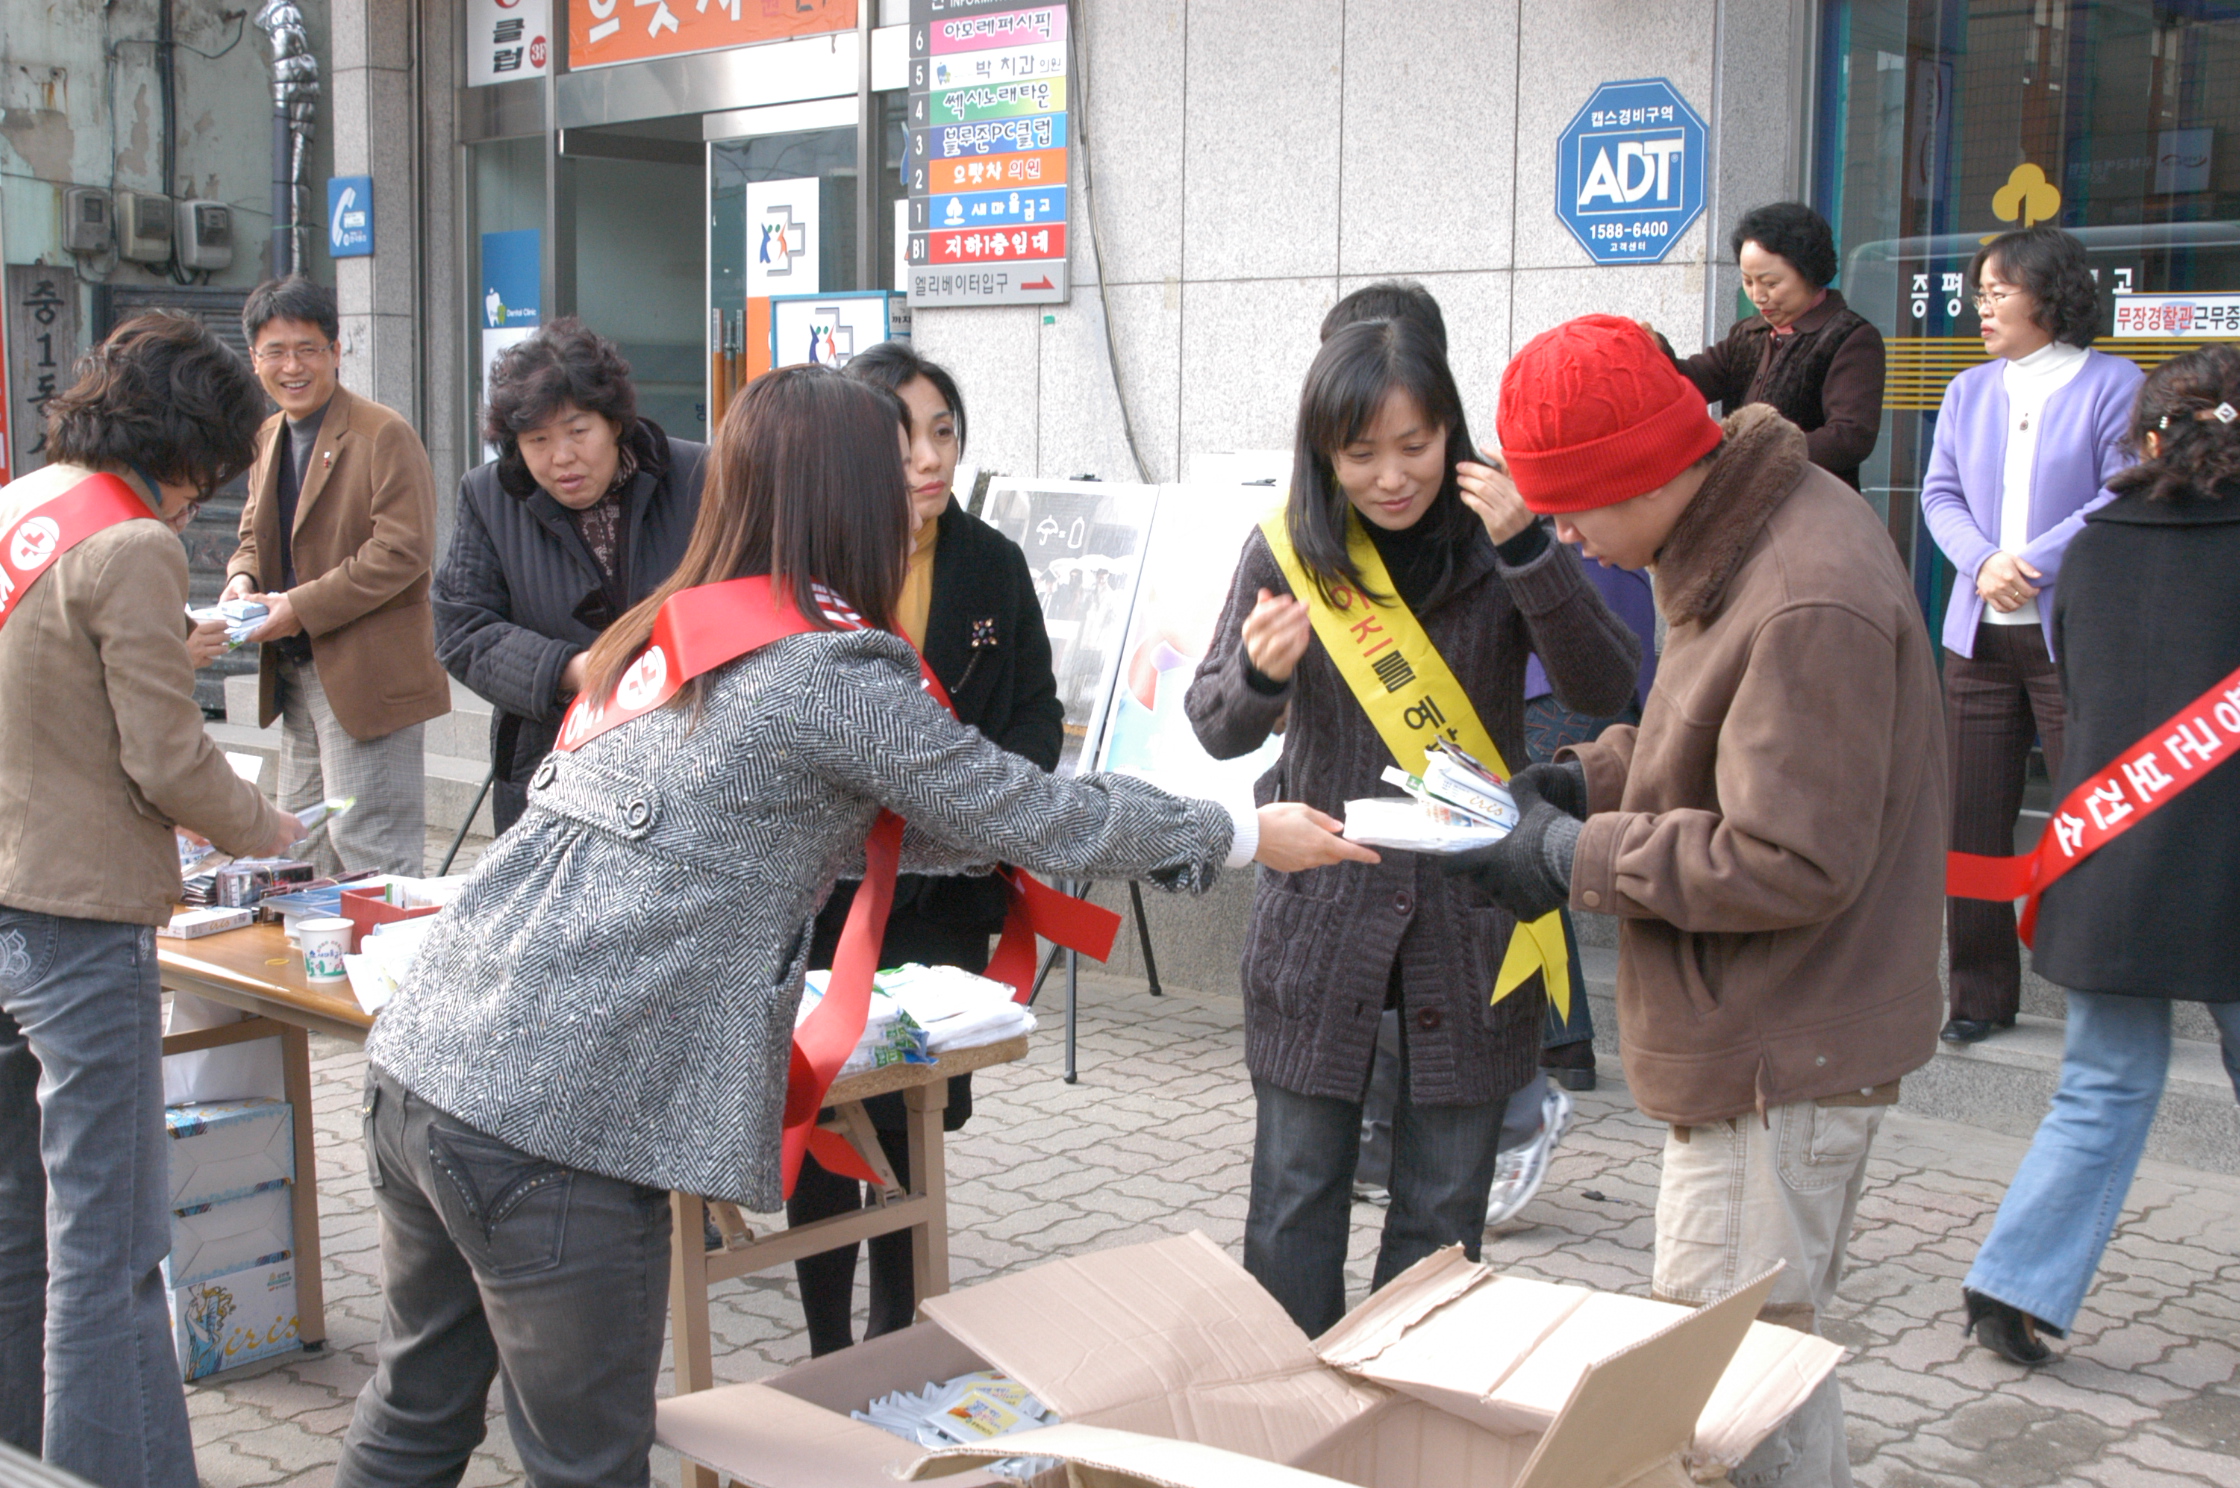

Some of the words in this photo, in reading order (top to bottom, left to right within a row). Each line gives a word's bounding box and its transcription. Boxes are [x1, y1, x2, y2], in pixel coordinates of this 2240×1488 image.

[945, 12, 1051, 39] 아모레퍼시픽
[493, 18, 524, 73] 클럽
[915, 30, 924, 51] 6
[915, 65, 924, 86] 5
[915, 100, 924, 120] 4
[1591, 105, 1674, 128] 캡스경비구역
[915, 136, 924, 155] 3
[944, 118, 1051, 155] 블루존PC클럽
[915, 169, 923, 189] 2
[1009, 159, 1041, 180] 의원
[1579, 138, 1683, 205] ADT
[916, 203, 922, 223] 1
[971, 192, 1050, 222] 새마을금고
[1590, 220, 1668, 239] 1588-6400
[912, 239, 925, 259] B1
[1610, 241, 1646, 252] 고객센터
[915, 273, 1008, 297] 엘리베이터입구
[506, 308, 522, 317] Dental
[523, 307, 537, 317] Clinic
[1469, 795, 1504, 817] iris
[225, 1314, 301, 1357] iris
